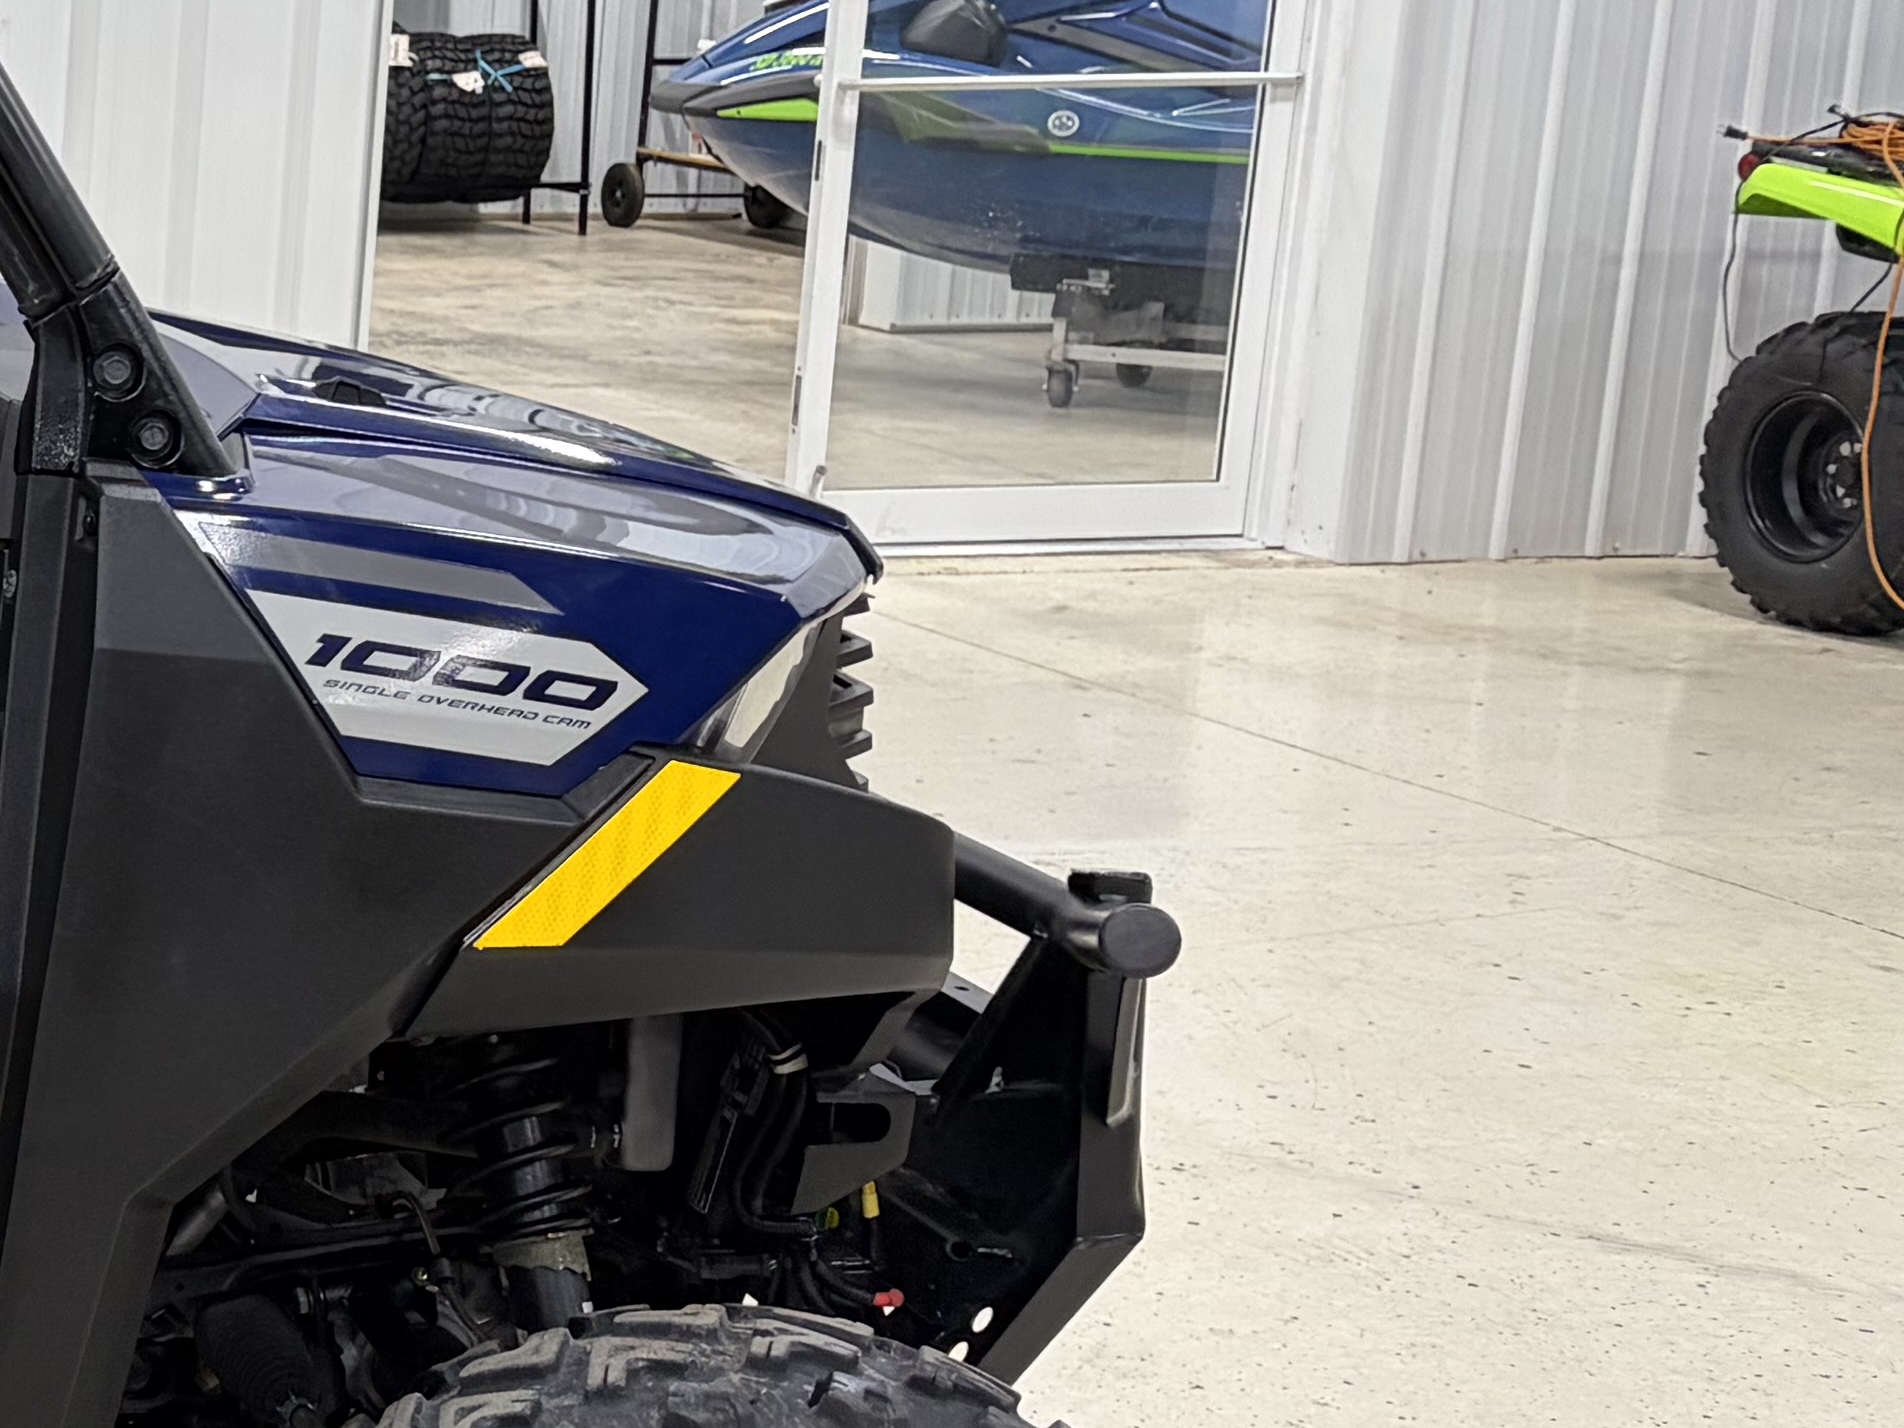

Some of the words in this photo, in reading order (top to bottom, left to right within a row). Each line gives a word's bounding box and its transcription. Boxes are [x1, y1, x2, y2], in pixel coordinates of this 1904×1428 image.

[304, 632, 619, 712] 1000
[321, 678, 410, 701] SINGLE
[417, 694, 540, 721] OVERHEAD
[542, 714, 592, 730] CAM
